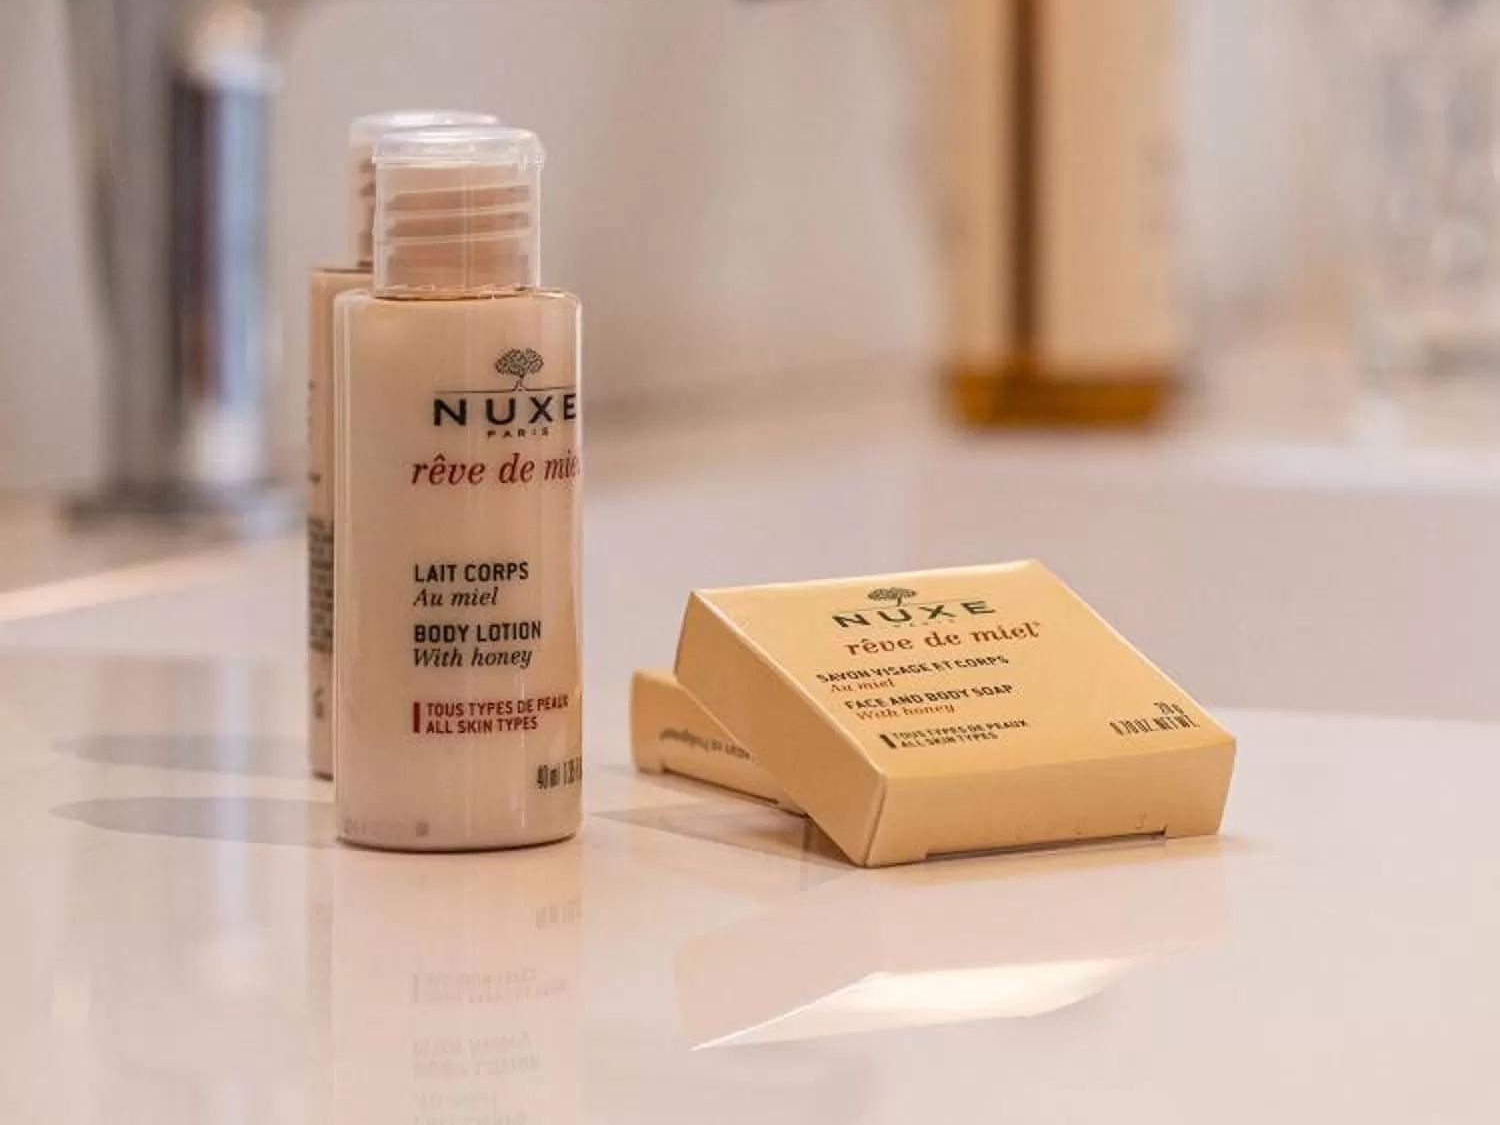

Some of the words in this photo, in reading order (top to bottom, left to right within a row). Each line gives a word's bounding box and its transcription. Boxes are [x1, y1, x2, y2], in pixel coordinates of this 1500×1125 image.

[434, 393, 576, 426] NUXE
[487, 427, 549, 438] PARIS
[412, 453, 485, 485] rêve
[500, 452, 535, 483] de
[545, 450, 580, 480] mie
[414, 564, 457, 582] LAIT
[464, 562, 529, 581] CORPS
[413, 588, 443, 606] Au
[451, 586, 499, 606] miel
[832, 600, 996, 628] NUXE
[415, 624, 469, 642] BODY
[477, 621, 541, 642] LOTION
[845, 638, 913, 655] rêve
[924, 631, 961, 648] de
[413, 648, 463, 667] With
[471, 647, 533, 669] honey
[845, 698, 888, 709] FACE
[889, 694, 923, 705] AND
[924, 689, 969, 702] BODY
[971, 684, 1013, 696] SOAP
[426, 702, 465, 717] TOUS
[469, 701, 513, 716] TYPES
[517, 699, 534, 713] DE
[426, 719, 453, 734] ALL
[458, 719, 493, 734] SKIN
[497, 716, 539, 732] TYPES
